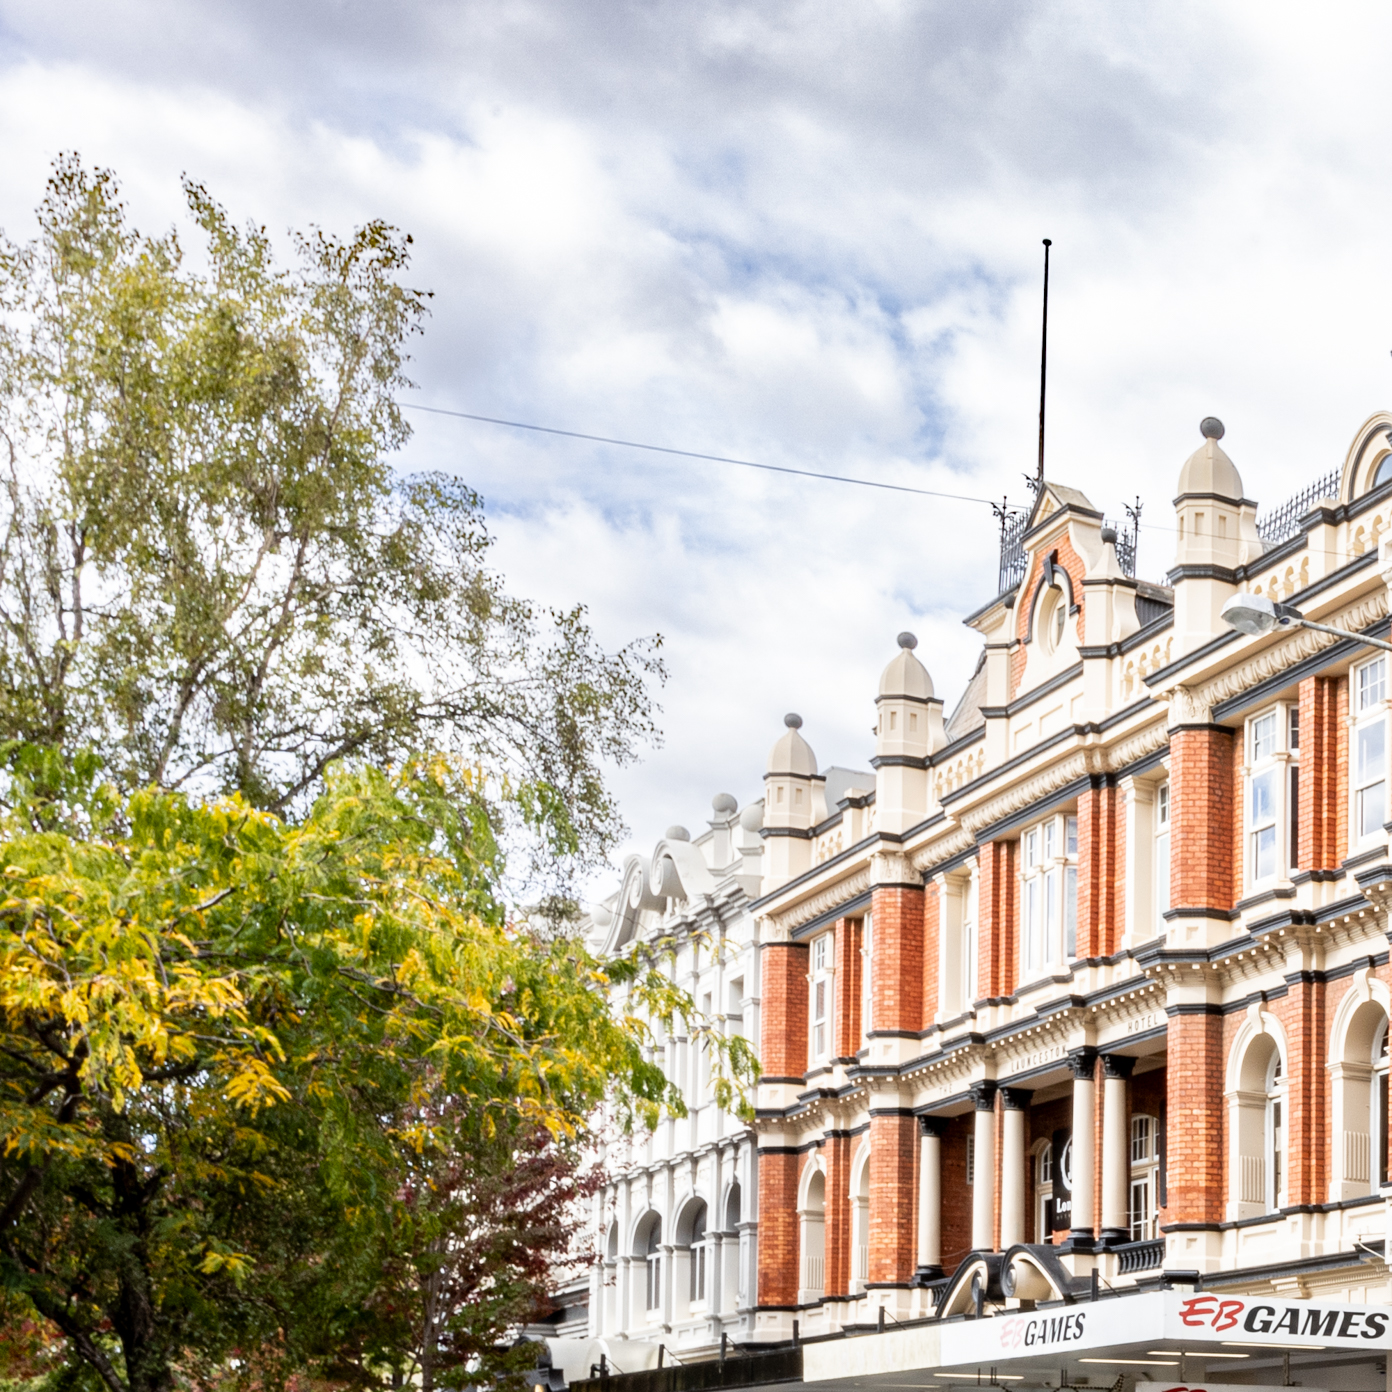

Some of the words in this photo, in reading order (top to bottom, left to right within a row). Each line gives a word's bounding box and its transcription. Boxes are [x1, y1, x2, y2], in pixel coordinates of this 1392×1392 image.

[1127, 1015, 1159, 1034] HOTEL
[1010, 1044, 1068, 1074] LAUNCESTON
[1000, 1317, 1025, 1350] EB
[1023, 1311, 1087, 1347] GAMES
[1177, 1296, 1245, 1333] EB
[1242, 1305, 1391, 1340] GAMES
